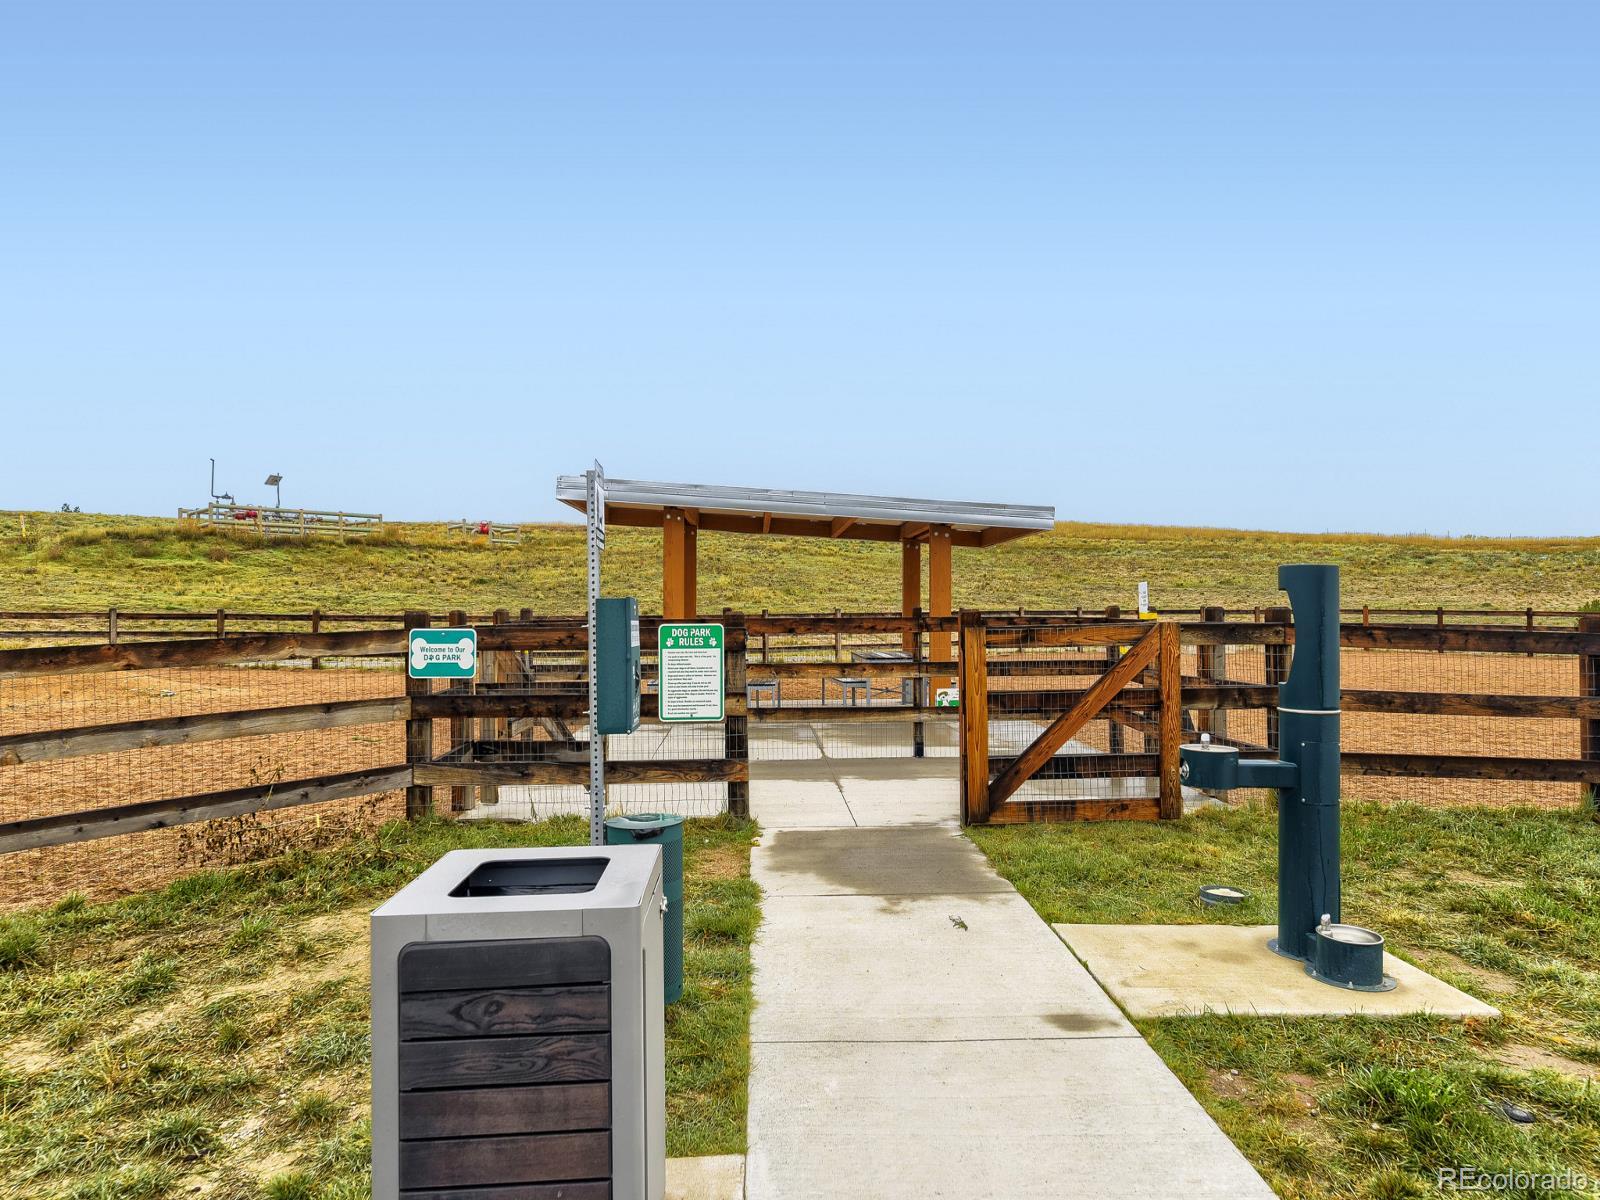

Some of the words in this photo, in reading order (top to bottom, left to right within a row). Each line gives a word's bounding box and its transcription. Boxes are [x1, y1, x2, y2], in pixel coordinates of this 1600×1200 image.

[671, 628, 689, 637] DOG
[690, 628, 711, 637] PARK
[679, 637, 704, 646] RULES
